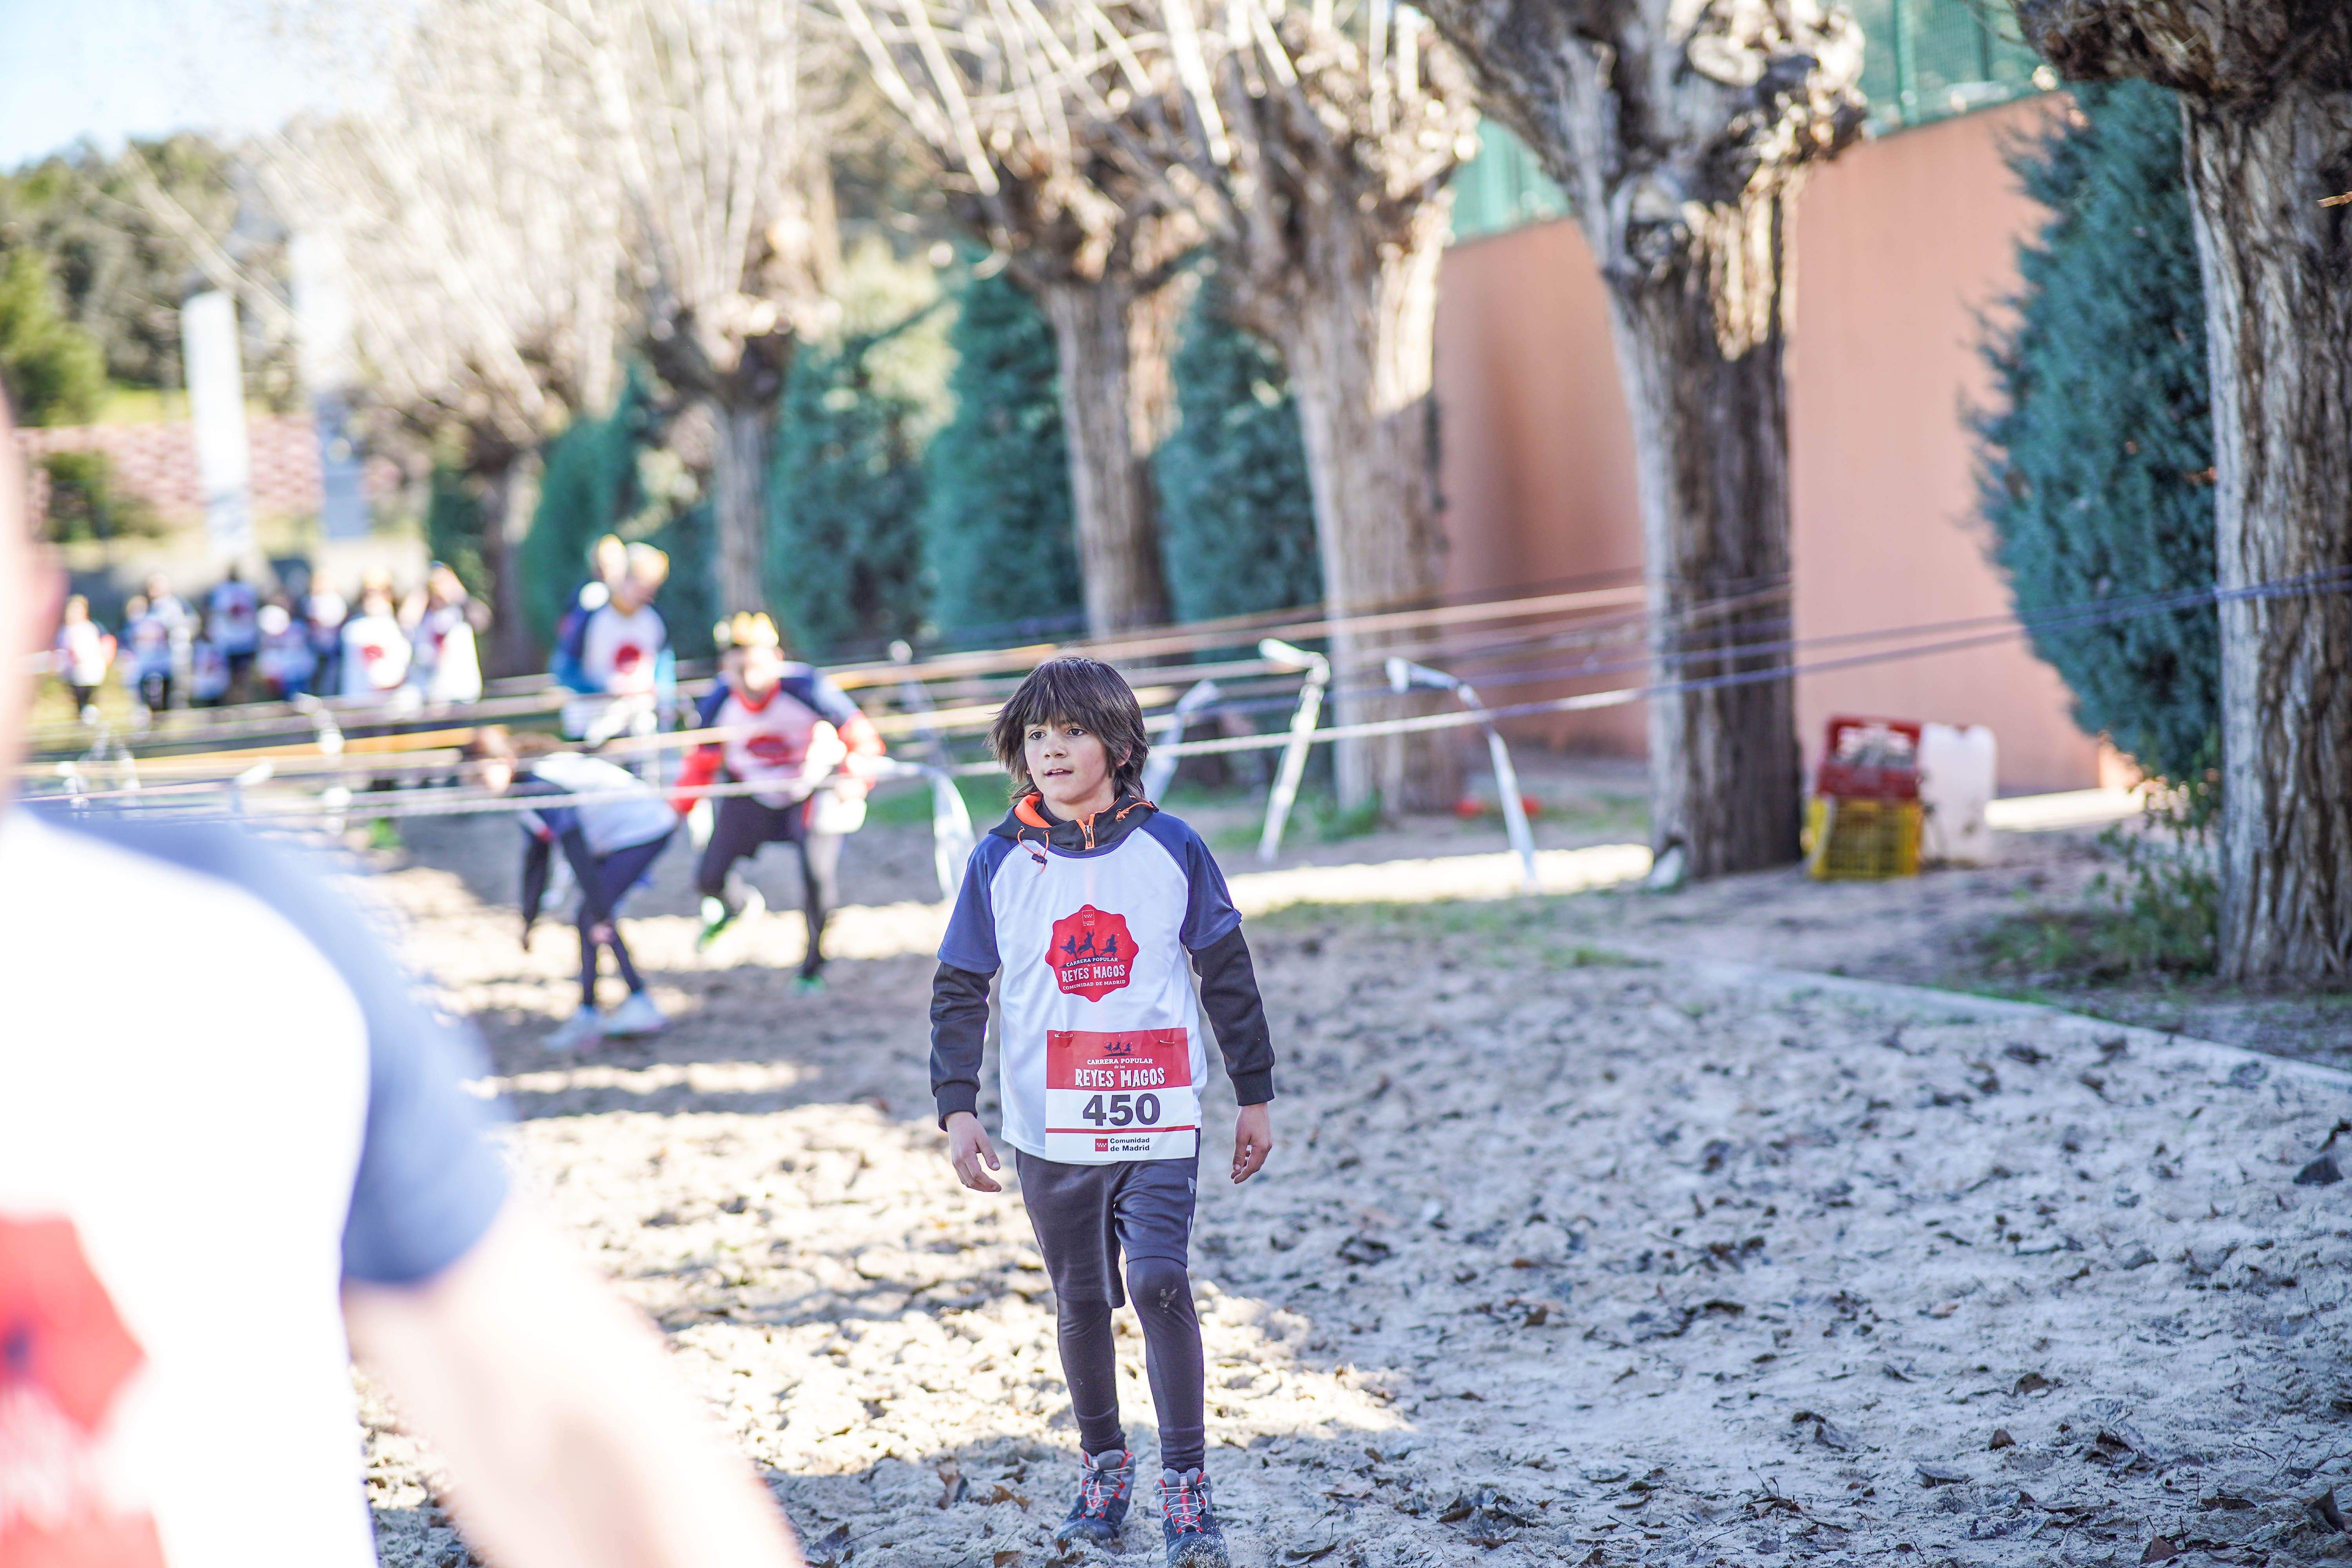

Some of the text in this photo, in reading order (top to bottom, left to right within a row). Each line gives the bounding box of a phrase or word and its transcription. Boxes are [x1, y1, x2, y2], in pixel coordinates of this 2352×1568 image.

[1066, 958, 1091, 967] CARRERA
[1062, 964, 1125, 983] REYES MAGOS
[1063, 982, 1094, 990] COMUNIDAD
[1075, 1067, 1165, 1087] REYES MAGOS
[1083, 1093, 1160, 1126] 450
